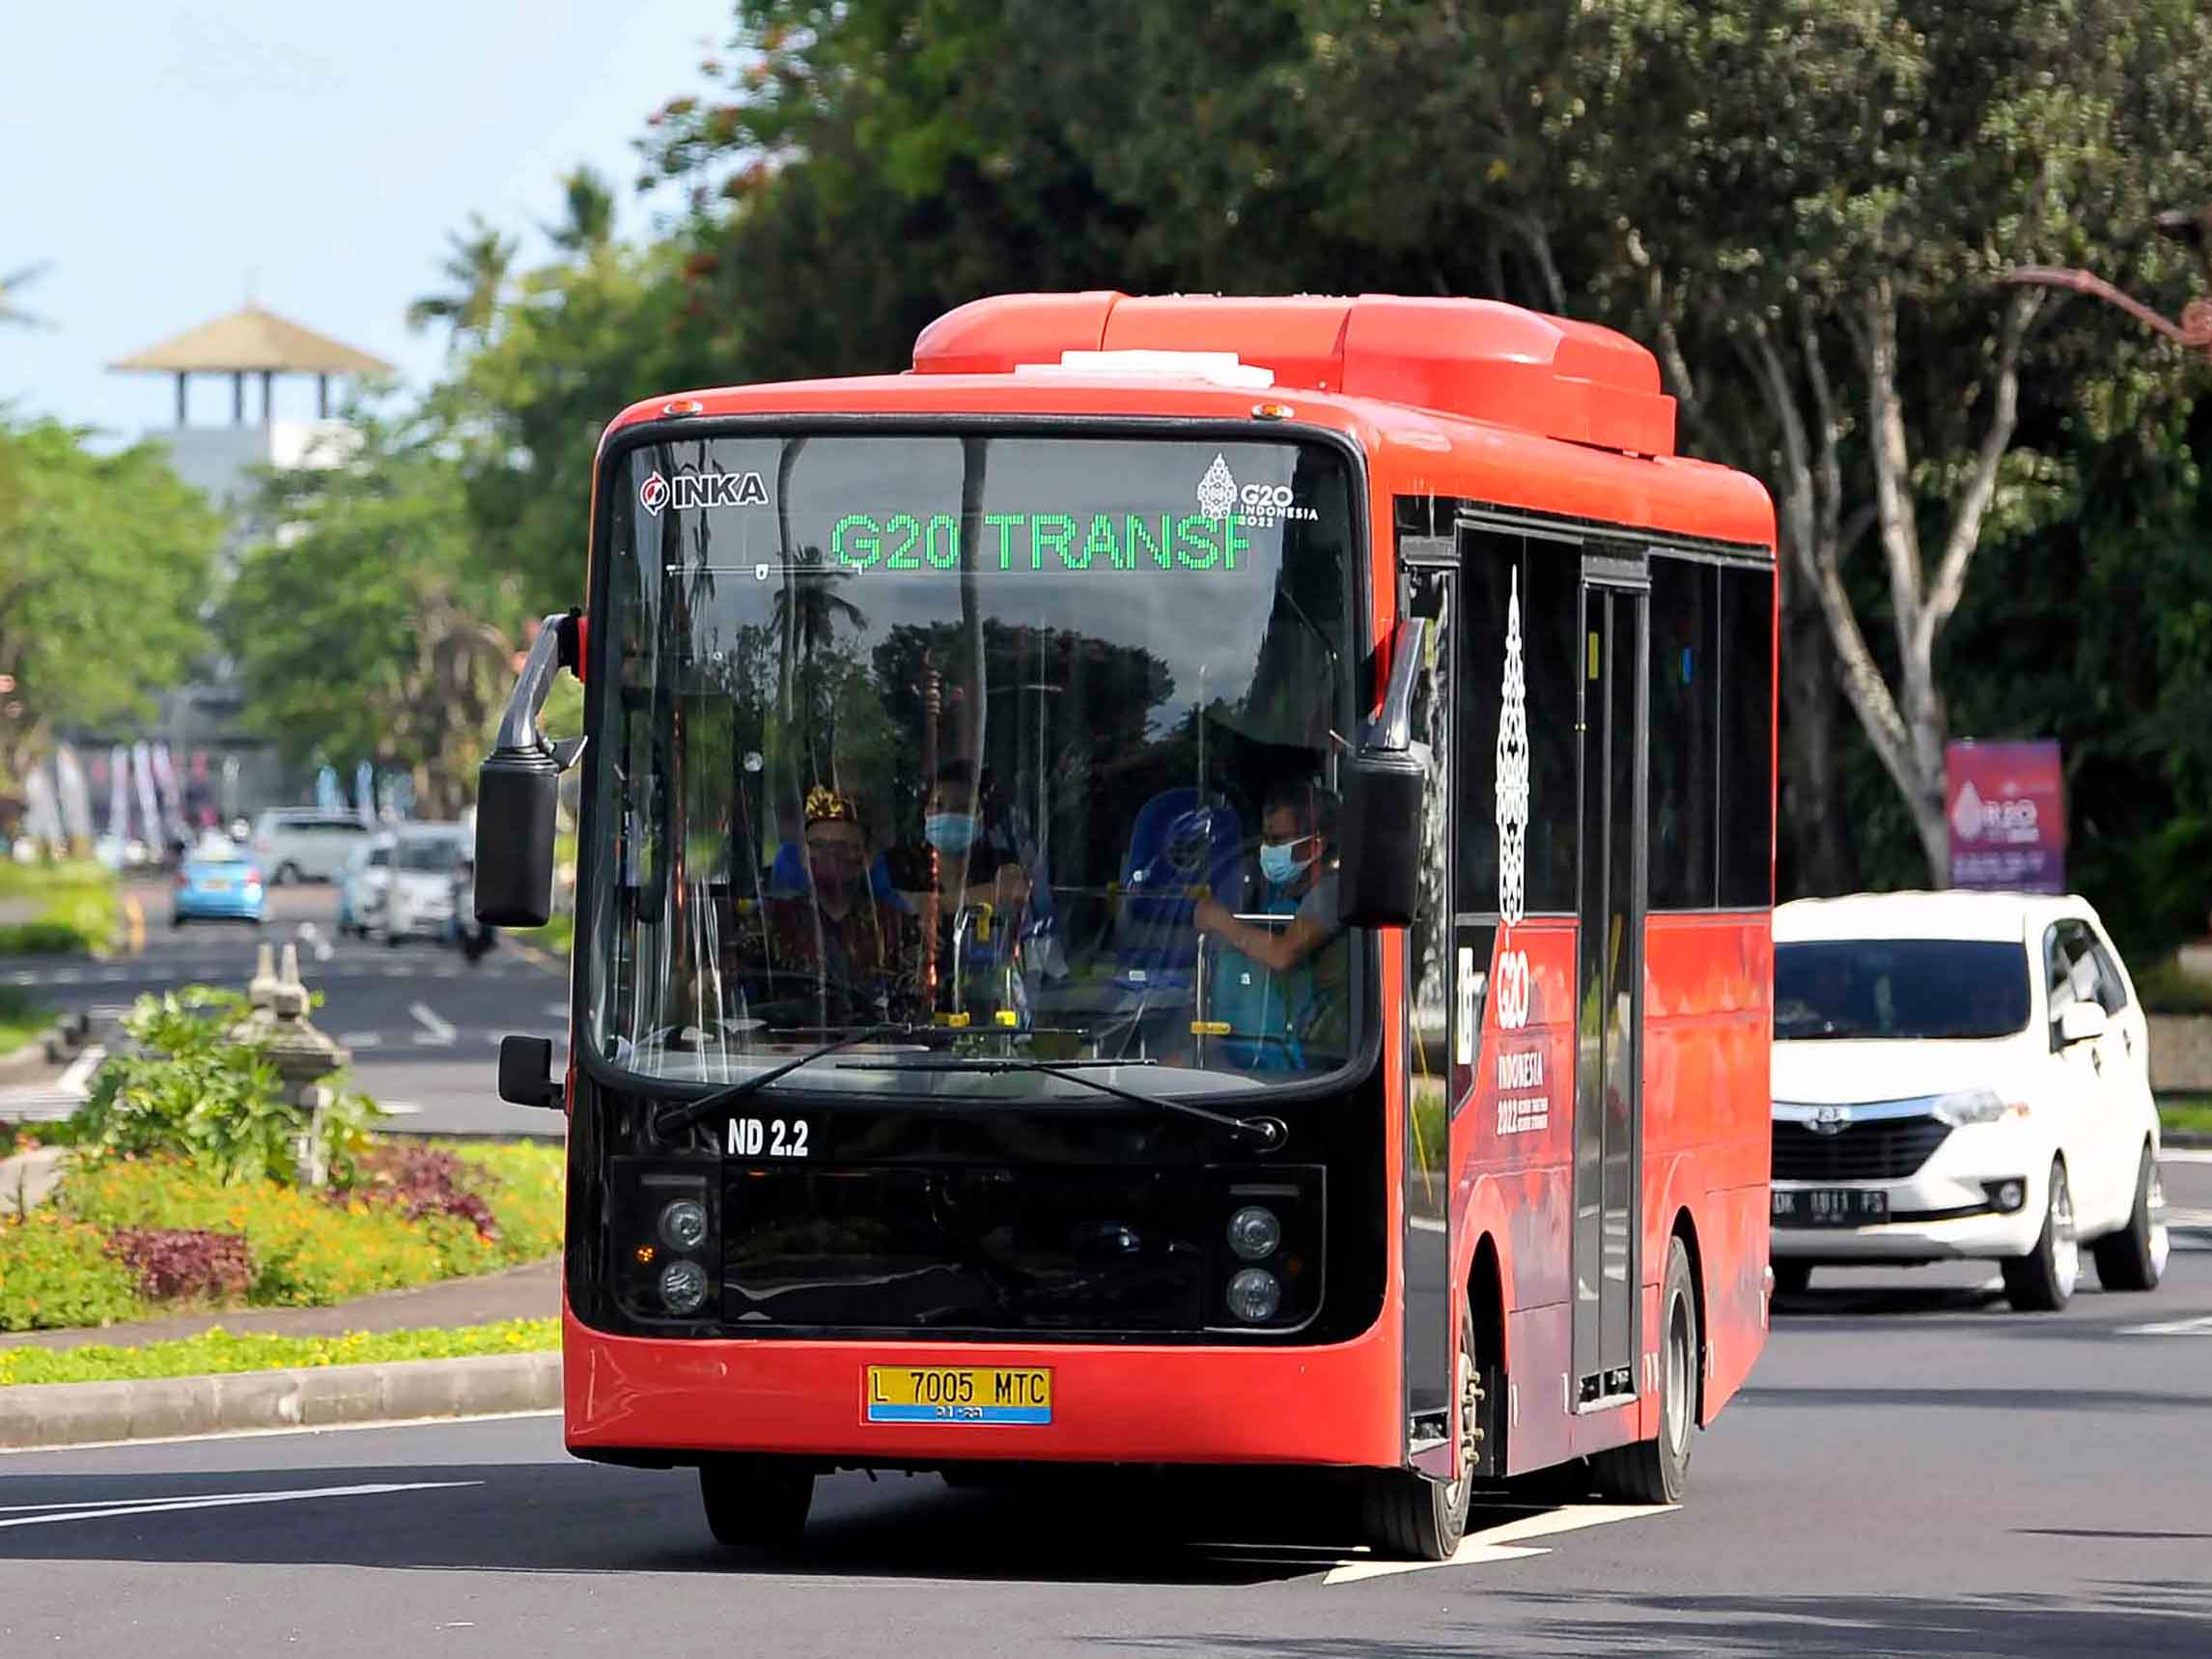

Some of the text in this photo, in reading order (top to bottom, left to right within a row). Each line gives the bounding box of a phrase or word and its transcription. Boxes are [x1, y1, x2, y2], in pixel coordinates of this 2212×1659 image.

[673, 472, 769, 509] INKA
[1240, 484, 1294, 507] G20
[1240, 503, 1319, 520] INDONESIA
[832, 515, 959, 569] G20
[1497, 949, 1528, 1029] G20
[1498, 1051, 1543, 1089] INDONESIA
[1497, 1098, 1518, 1135] 2022
[728, 1118, 808, 1156] ND 2.2
[873, 1372, 1045, 1404] L 7005 MTC
